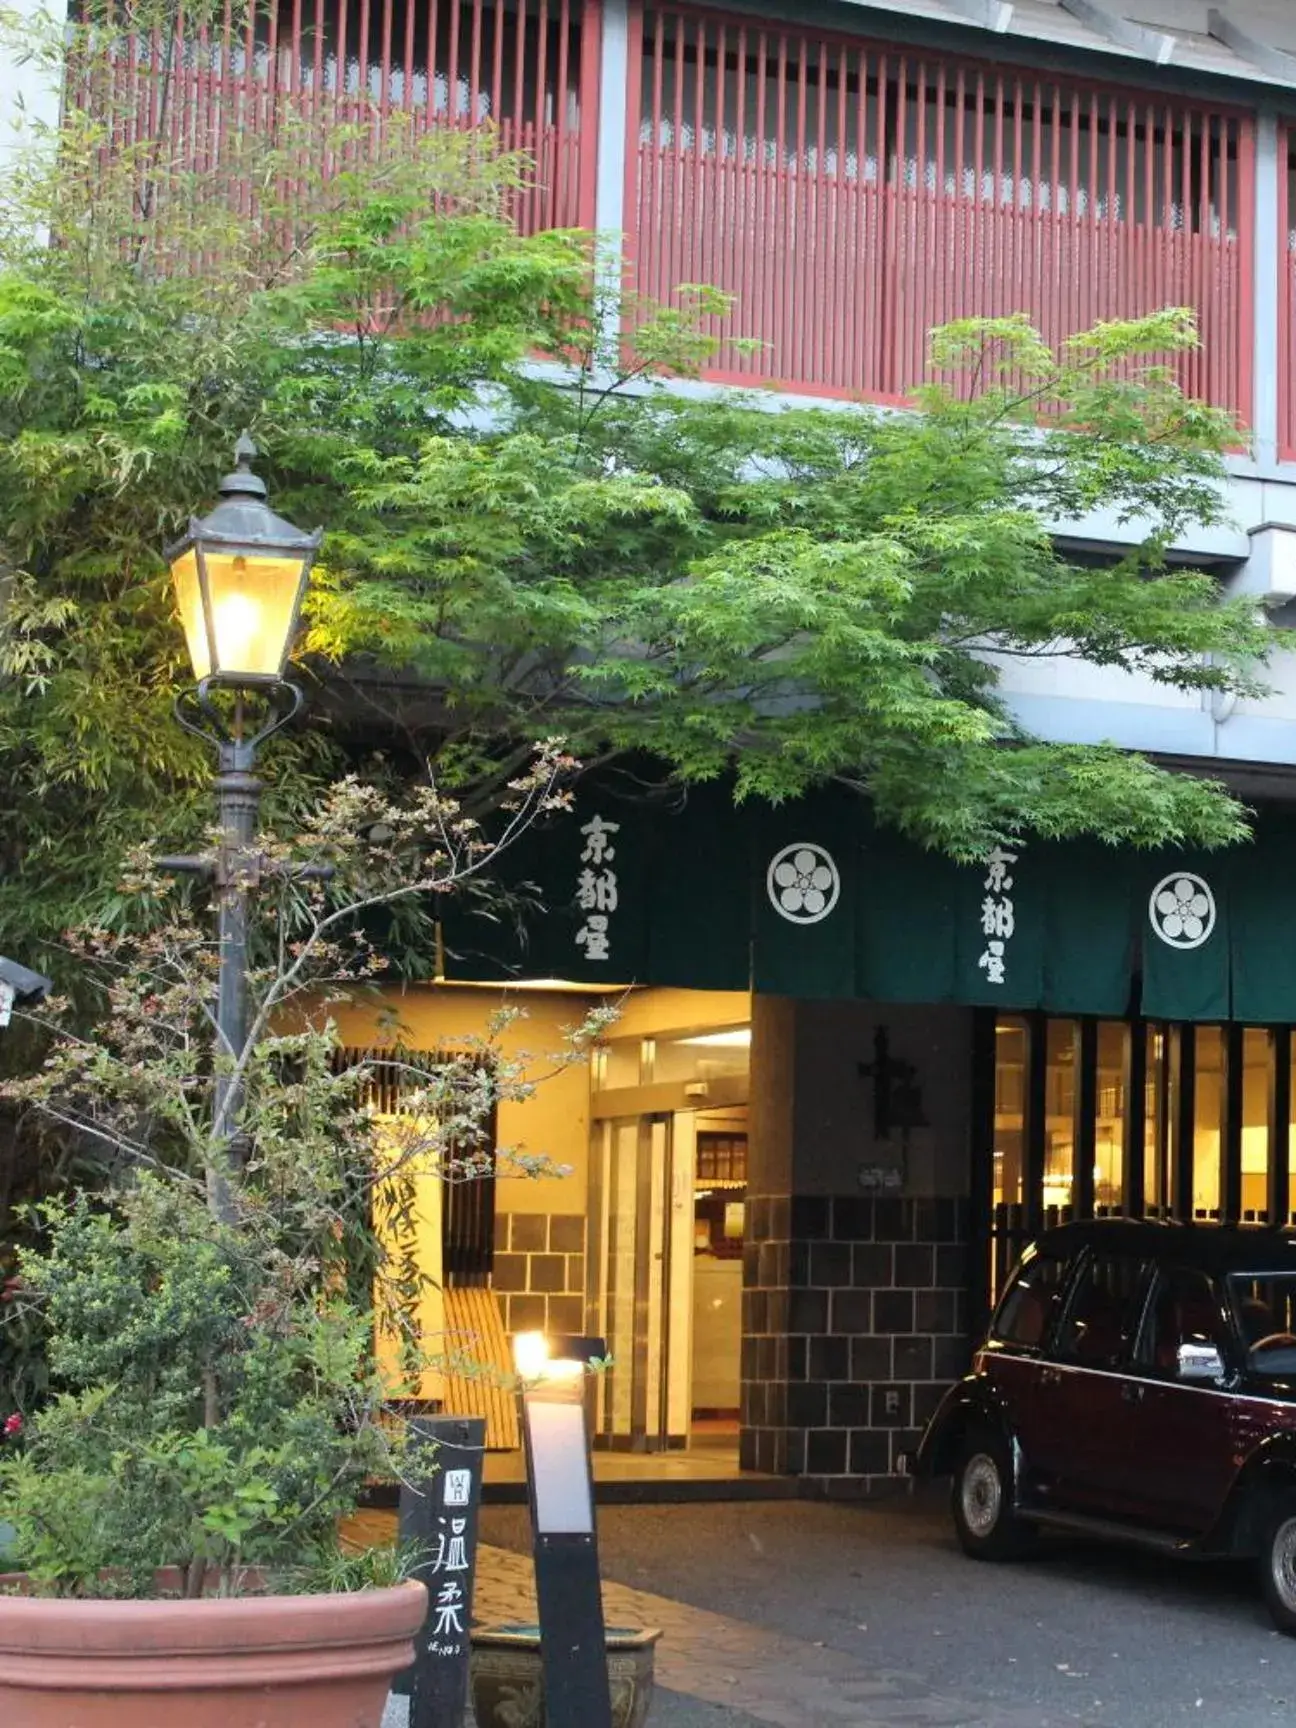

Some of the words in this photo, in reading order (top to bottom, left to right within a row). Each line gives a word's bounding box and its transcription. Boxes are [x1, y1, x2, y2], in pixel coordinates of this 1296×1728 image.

[576, 815, 620, 960] 京都屋
[979, 845, 1018, 984] 京都屋
